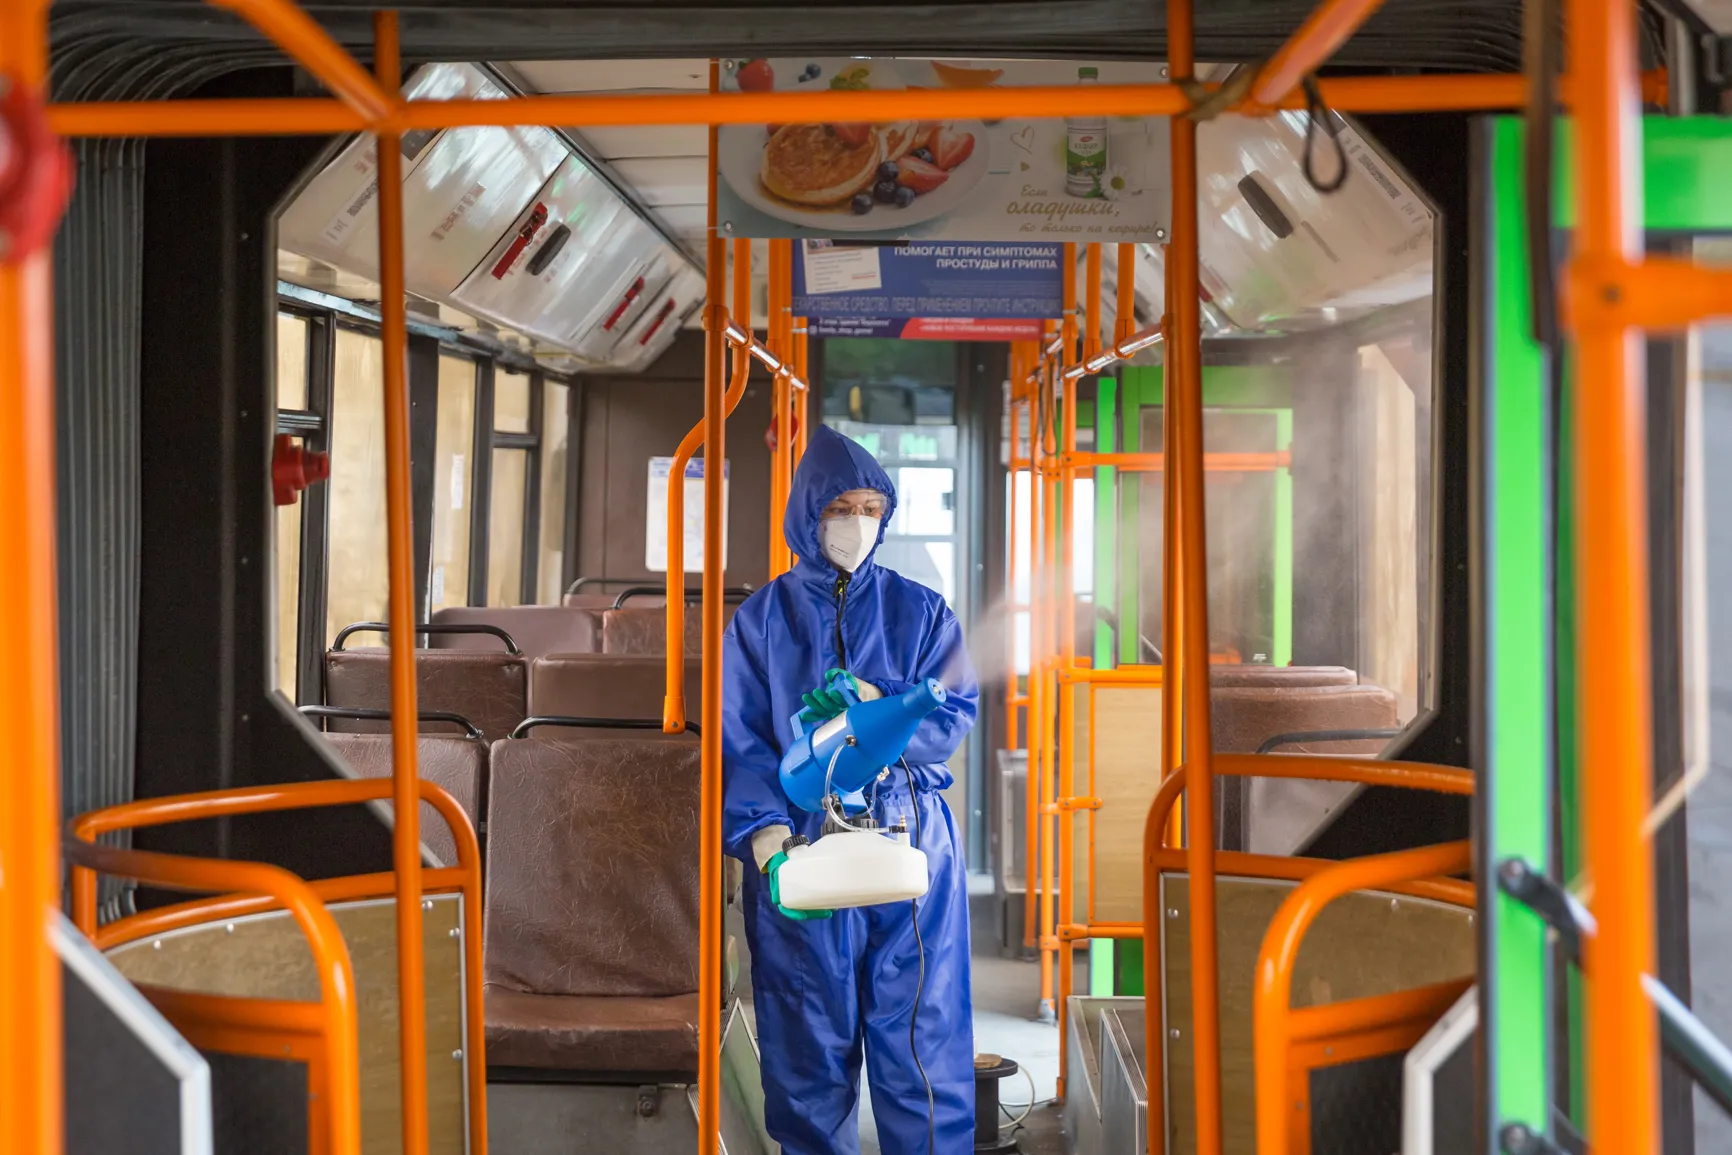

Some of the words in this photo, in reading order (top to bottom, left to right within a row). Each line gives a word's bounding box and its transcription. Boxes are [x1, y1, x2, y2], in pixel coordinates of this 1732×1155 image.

[1020, 185, 1048, 197] Если
[1006, 201, 1120, 221] оладушки,
[1019, 222, 1036, 232] то
[1041, 222, 1083, 233] только
[1087, 224, 1102, 233] на
[1107, 221, 1158, 236] кефире!
[893, 246, 955, 256] ПОМОГАЕТ
[957, 246, 981, 256] ПРИ
[983, 246, 1058, 257] СИМПТОМАХ
[936, 258, 999, 270] ПРОСТУДЫ
[1001, 259, 1010, 269] И
[1012, 259, 1058, 269] ГРИППА
